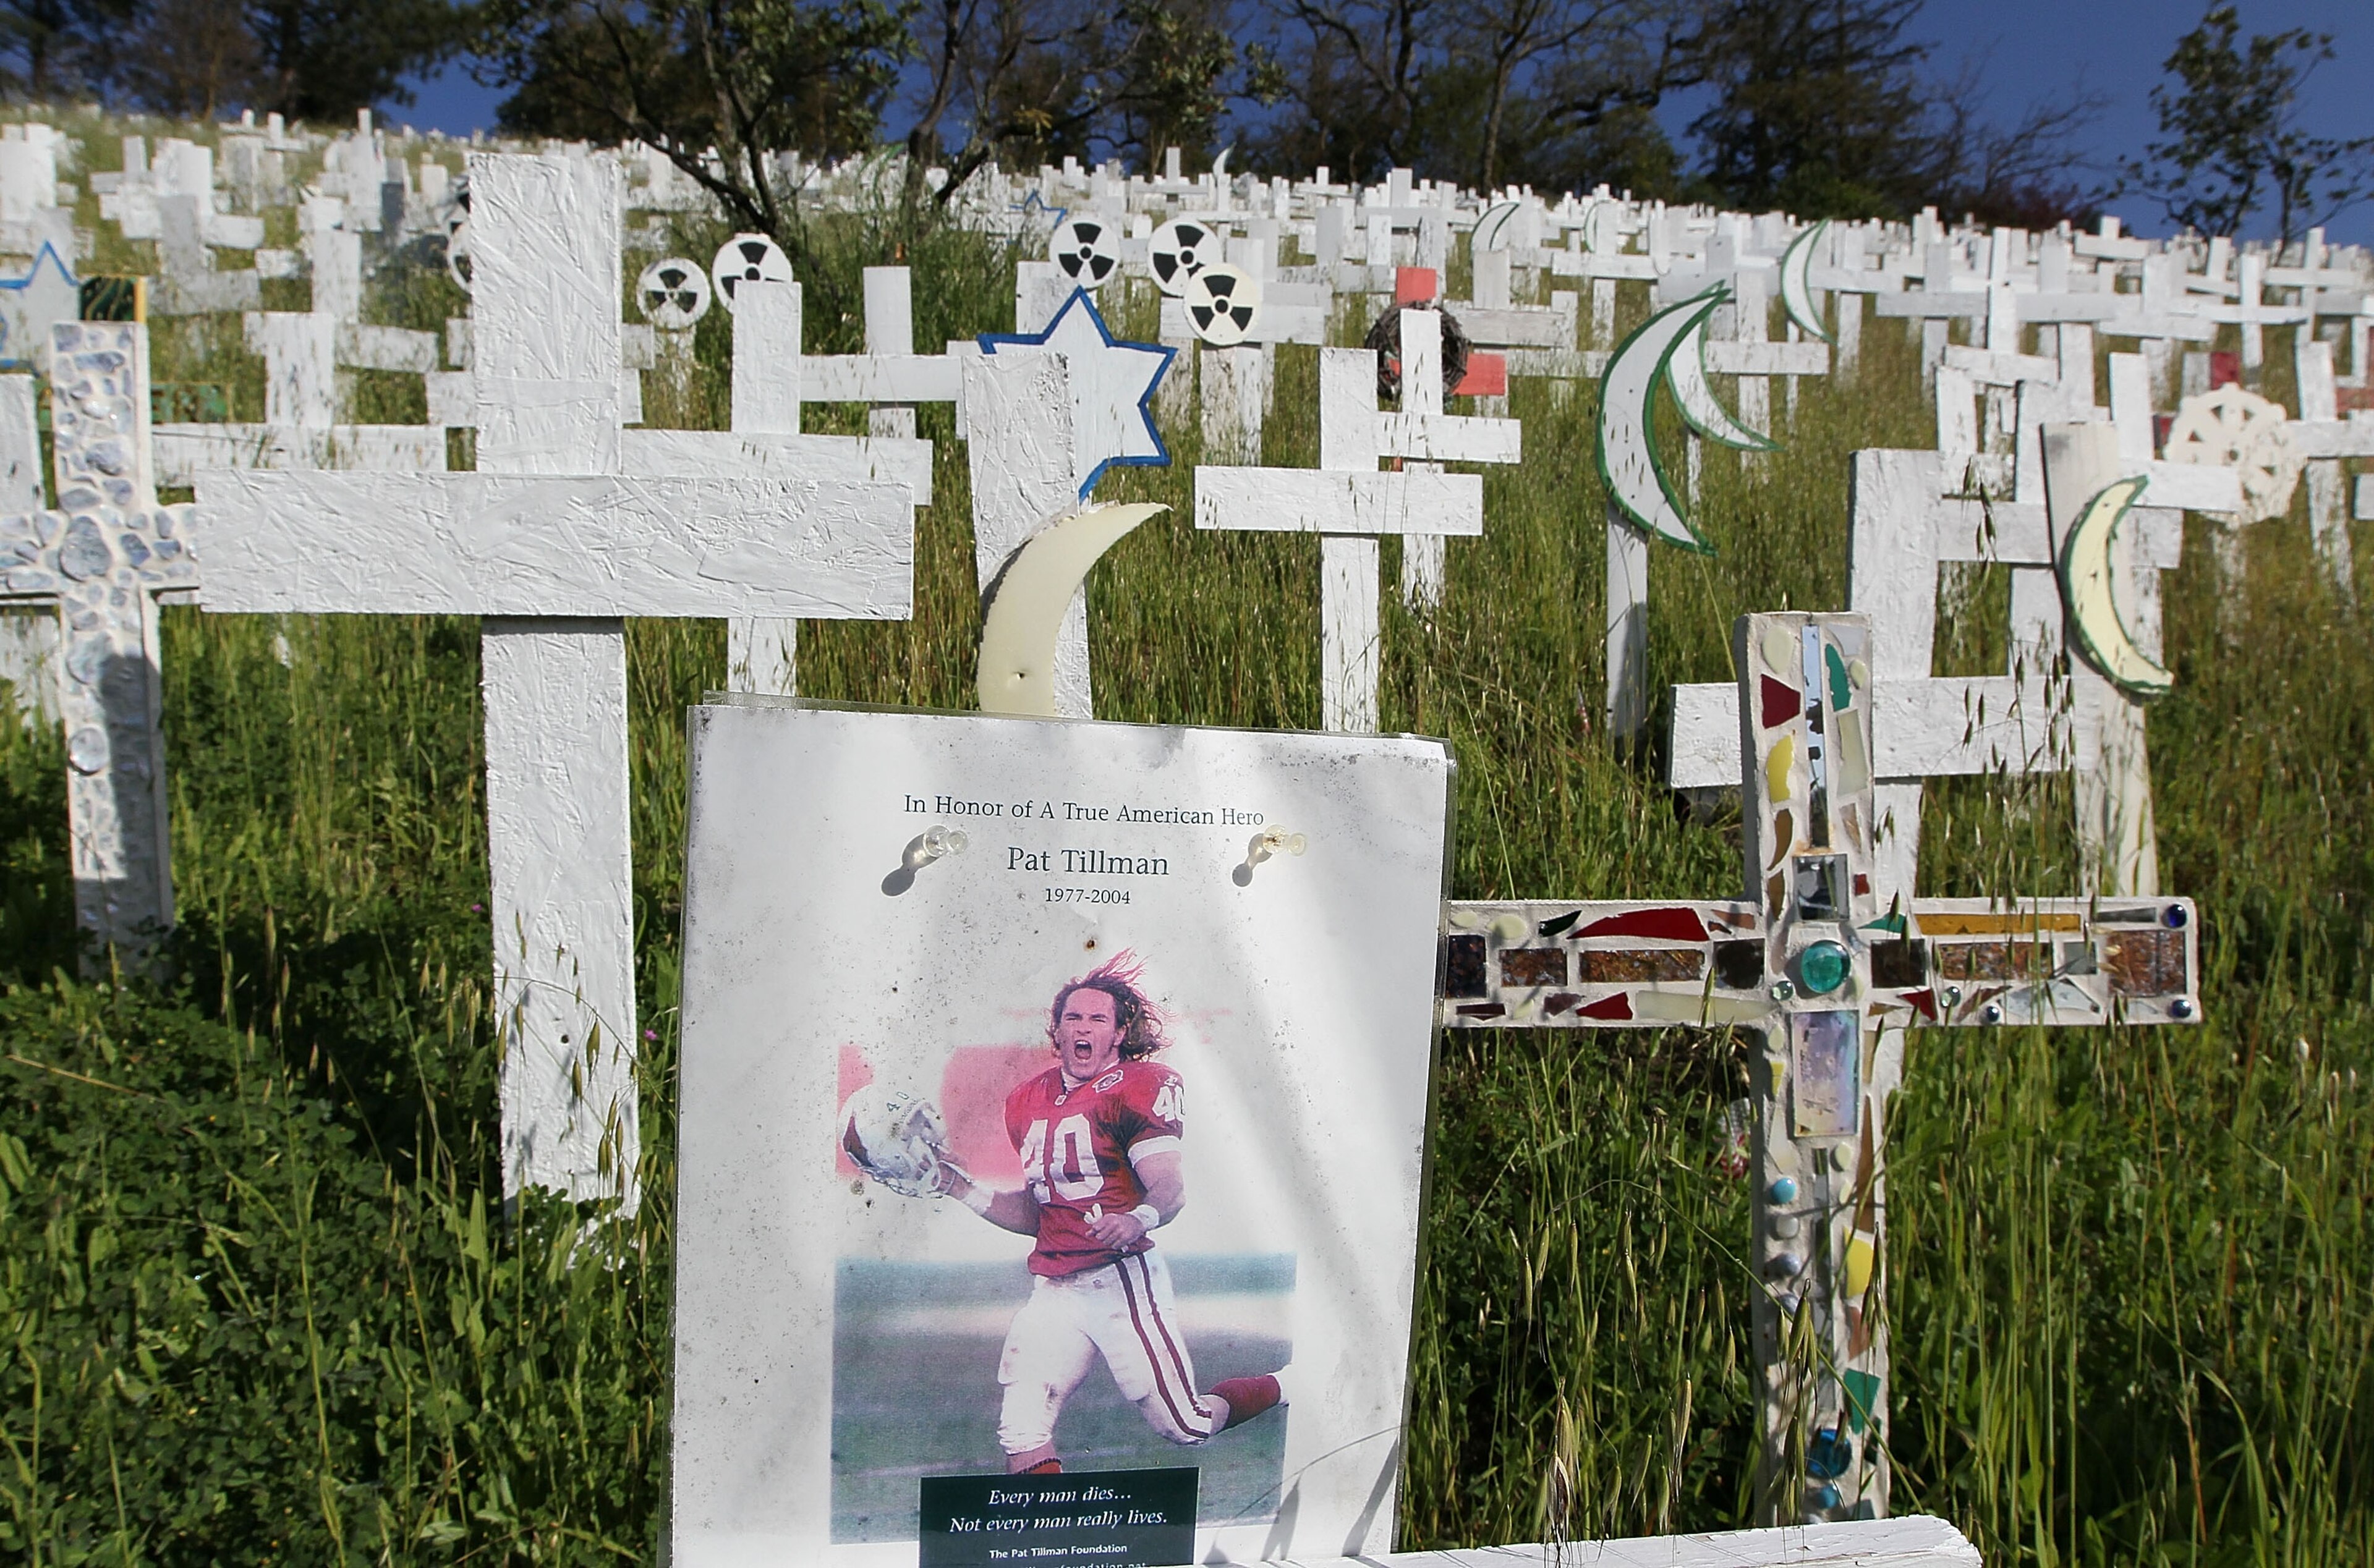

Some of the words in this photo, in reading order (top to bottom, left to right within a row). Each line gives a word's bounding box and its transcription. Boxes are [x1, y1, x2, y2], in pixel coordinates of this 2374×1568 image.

[903, 794, 927, 813] In
[934, 795, 1004, 816] Honor
[1011, 800, 1034, 818] of
[1039, 801, 1055, 820] A
[1062, 802, 1109, 821] True
[1116, 804, 1215, 824] American
[1221, 808, 1264, 826] Hero
[1006, 846, 1051, 871] Pat
[1060, 849, 1170, 876] Tillman
[1045, 888, 1131, 905] 1977-2004
[1020, 1113, 1105, 1203] 40
[988, 1490, 1034, 1507] Every
[1039, 1491, 1076, 1503] man
[950, 1517, 982, 1532] Not
[986, 1515, 1029, 1534] every
[1034, 1517, 1071, 1529] man
[1076, 1511, 1123, 1529] really
[1127, 1509, 1167, 1524] lives.
[989, 1549, 1008, 1559] The
[1011, 1549, 1027, 1557] Pat
[1031, 1547, 1068, 1557] Tillman
[1071, 1543, 1128, 1554] Foundation
